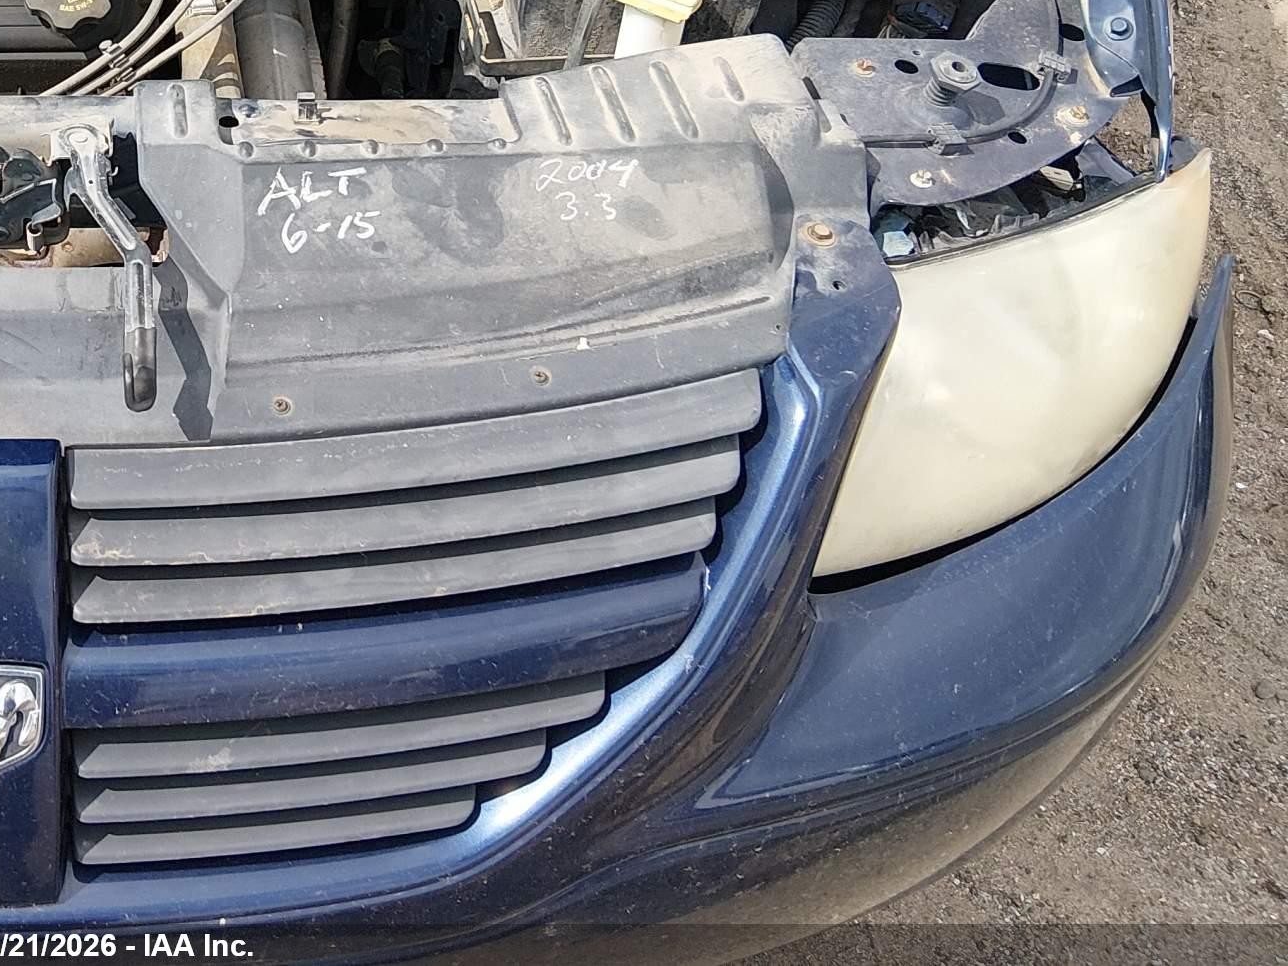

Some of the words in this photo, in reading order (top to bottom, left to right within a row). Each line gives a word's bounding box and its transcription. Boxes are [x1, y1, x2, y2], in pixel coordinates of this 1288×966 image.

[256, 166, 367, 216] ALT
[535, 158, 640, 192] 2004
[554, 191, 617, 220] 3.3
[281, 211, 380, 253] 6-15
